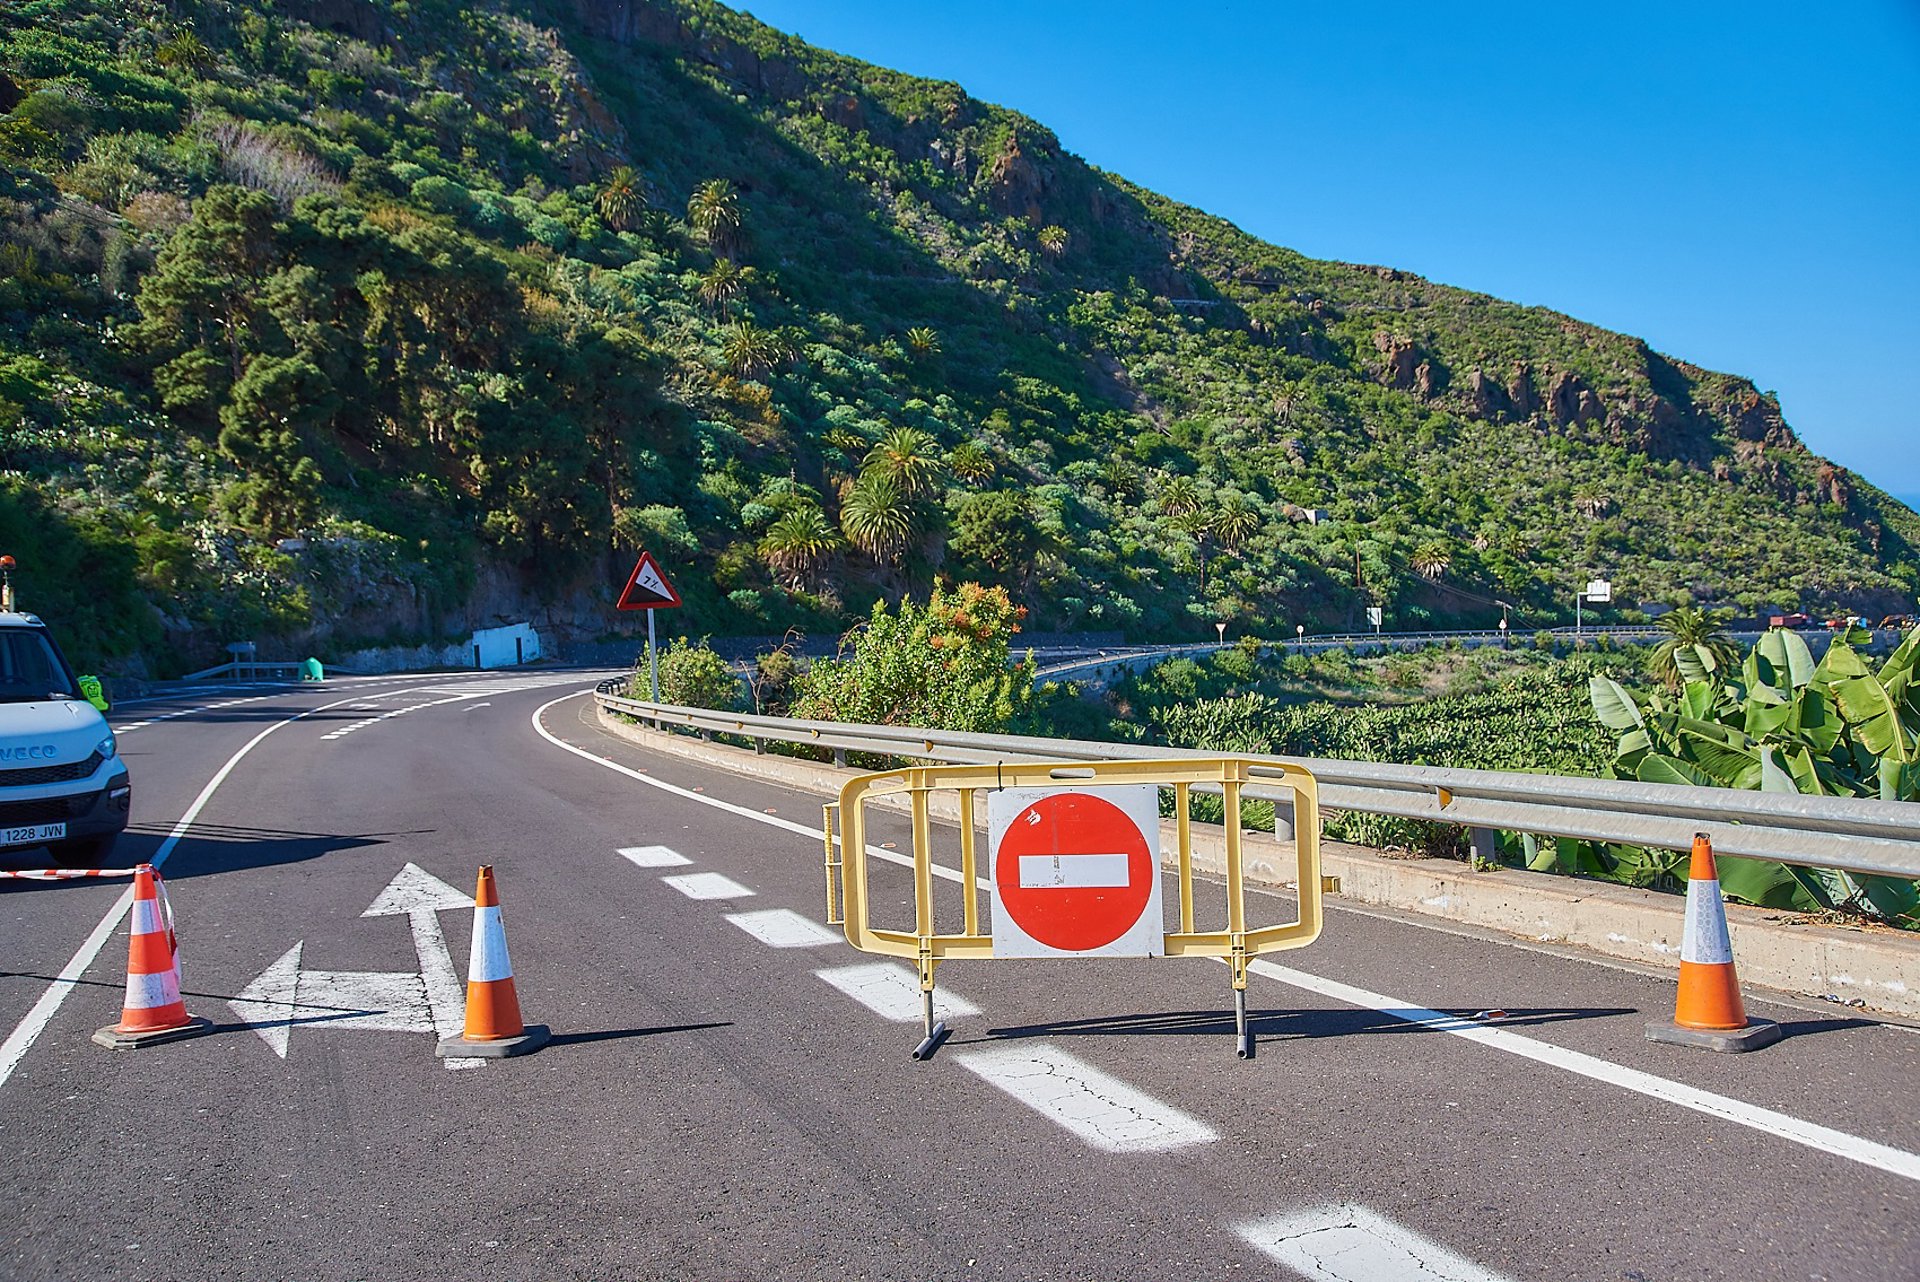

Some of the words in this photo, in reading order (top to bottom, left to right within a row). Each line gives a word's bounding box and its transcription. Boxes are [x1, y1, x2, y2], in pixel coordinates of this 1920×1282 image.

[643, 575, 659, 589] 7%
[7, 828, 35, 841] 1228
[40, 825, 62, 838] JVN
